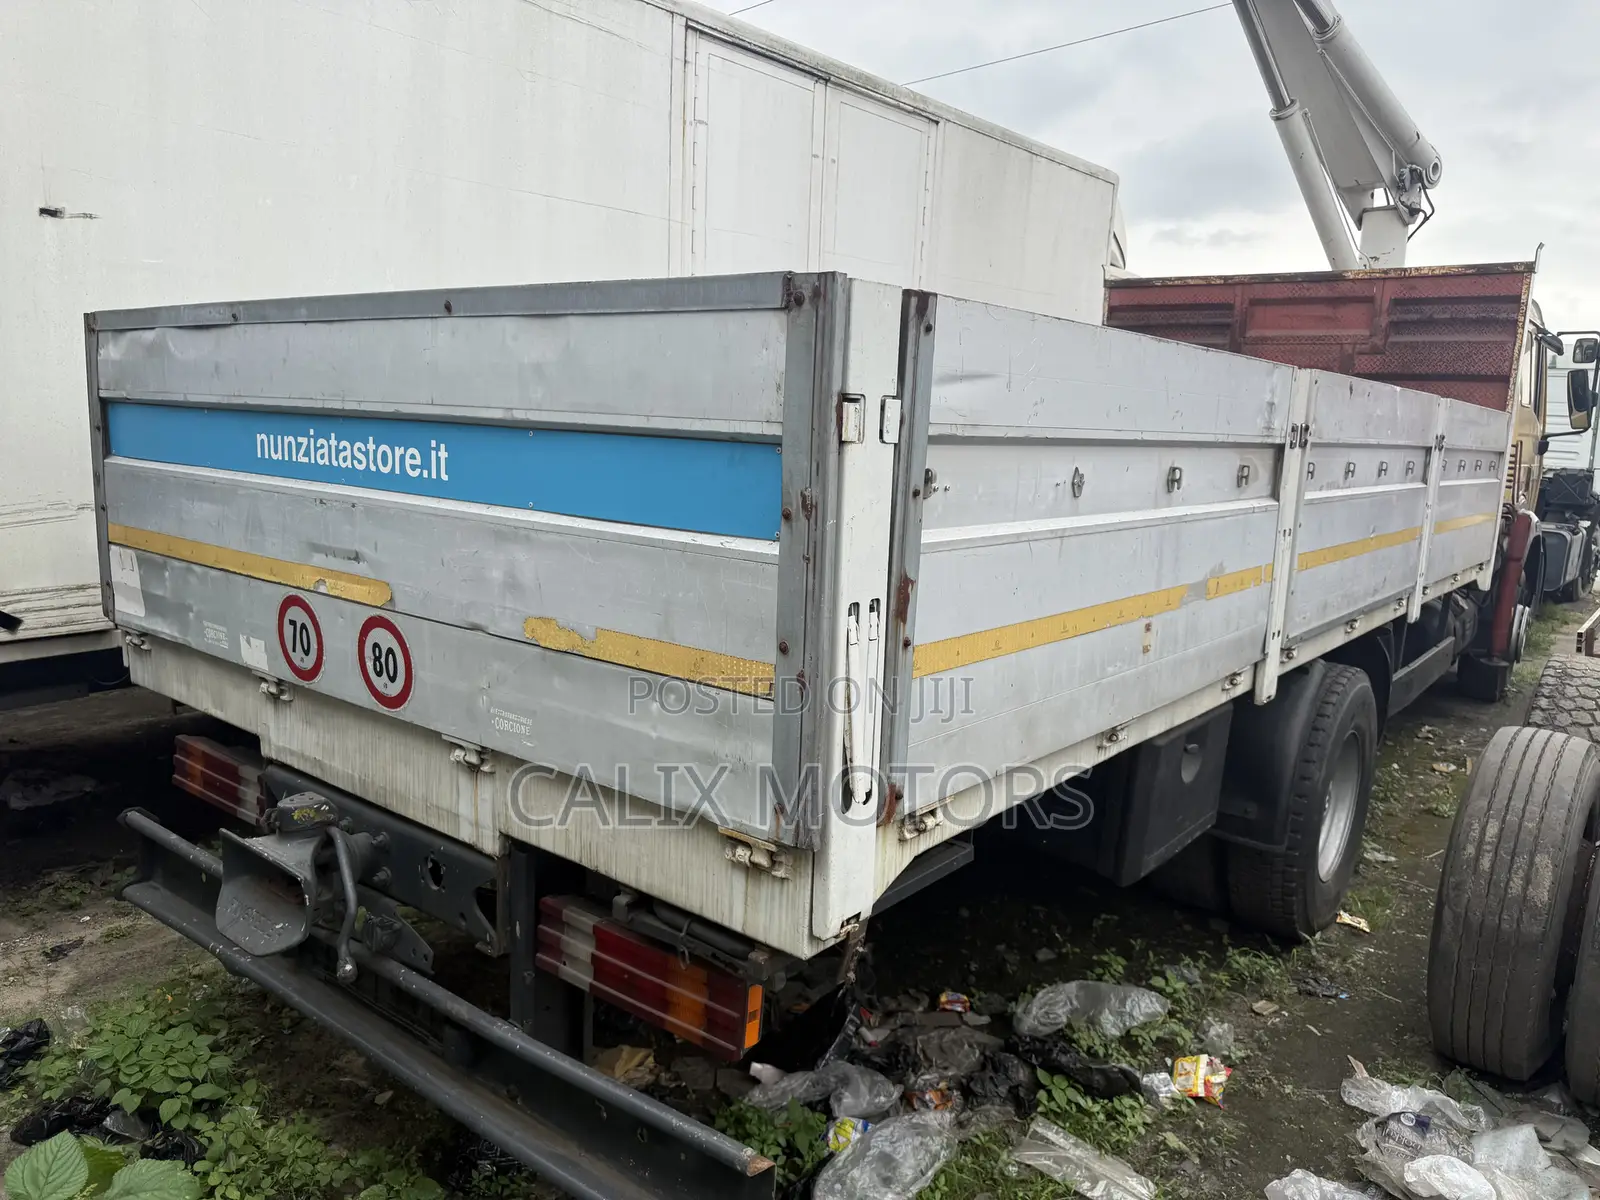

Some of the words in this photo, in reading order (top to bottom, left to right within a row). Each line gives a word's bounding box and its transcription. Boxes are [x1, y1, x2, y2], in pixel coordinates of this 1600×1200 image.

[256, 428, 449, 481] nunziatastore.it
[288, 618, 311, 657] 70
[371, 641, 398, 684] 80
